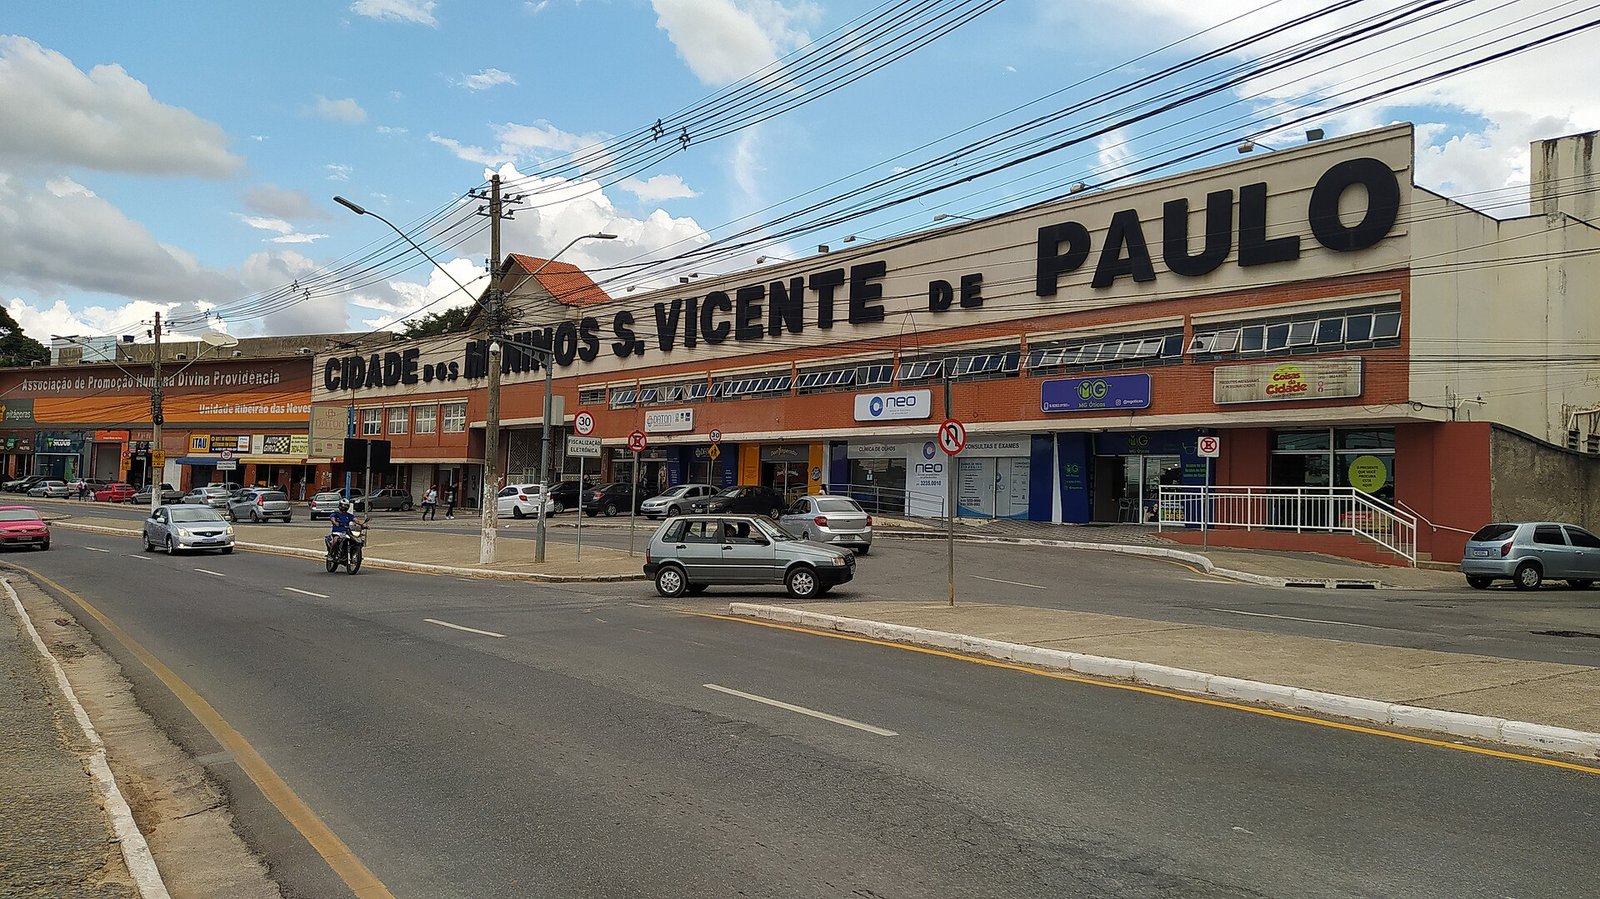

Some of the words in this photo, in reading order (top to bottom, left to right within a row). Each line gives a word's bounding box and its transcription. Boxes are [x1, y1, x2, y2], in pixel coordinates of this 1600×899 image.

[324, 347, 420, 391] CIDADE
[423, 361, 459, 383] DOS
[463, 316, 600, 379] MNINOS
[611, 310, 646, 358] S.
[654, 260, 887, 352] VICENTE
[929, 272, 985, 313] DE
[1036, 157, 1400, 297] PAULO
[22, 377, 72, 393] Associação
[74, 376, 85, 389] de
[88, 374, 133, 392] Promoção
[136, 373, 174, 388] Humna
[178, 372, 210, 387] Divina
[213, 369, 280, 386] Providência
[1272, 371, 1301, 381] Coisas
[1265, 382, 1308, 396] Cidade
[886, 395, 916, 407] neo
[6, 407, 31, 421] pitágoras
[199, 403, 233, 414] Unidade
[235, 403, 269, 414] Ribeirão
[270, 403, 285, 413] das
[286, 402, 311, 413] Neves
[578, 416, 591, 427] 30
[192, 436, 207, 449] ITAÚ
[915, 463, 943, 473] neo
